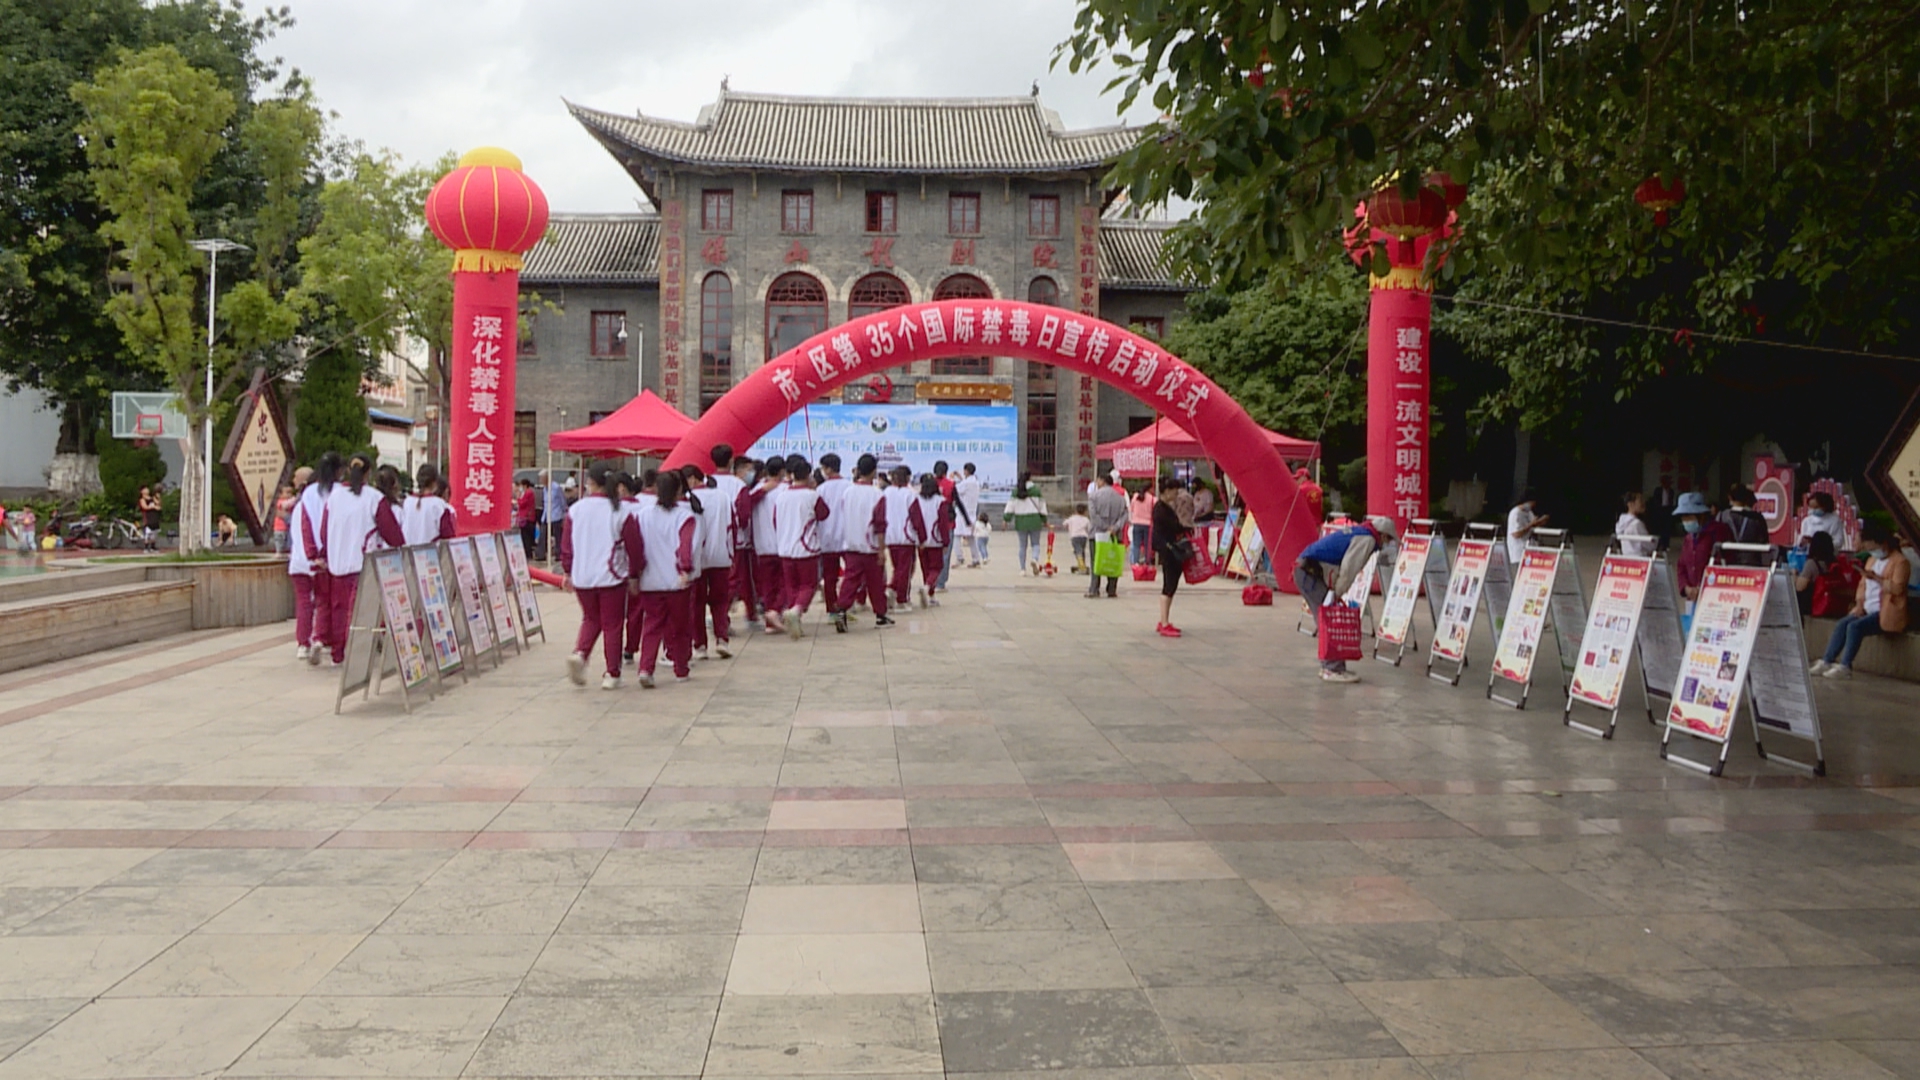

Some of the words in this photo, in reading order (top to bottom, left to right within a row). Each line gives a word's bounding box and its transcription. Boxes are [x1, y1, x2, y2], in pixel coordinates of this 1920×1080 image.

[464, 316, 502, 516] 深化禁毒人民战争
[1395, 328, 1422, 519] 建设一流文明城市
